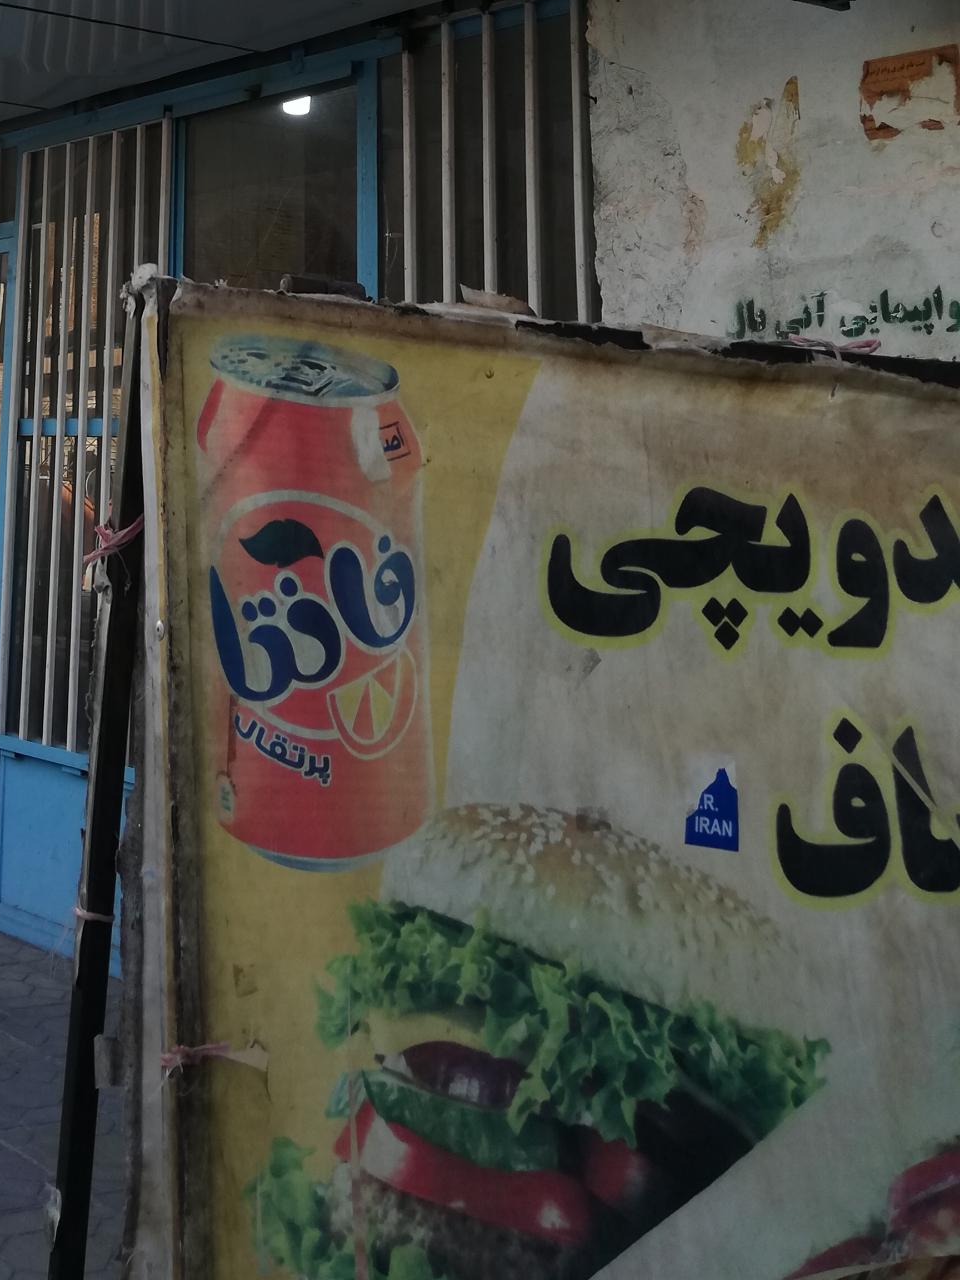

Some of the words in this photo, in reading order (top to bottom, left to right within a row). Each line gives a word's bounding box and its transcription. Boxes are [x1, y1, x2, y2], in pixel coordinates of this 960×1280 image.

[209, 533, 417, 703] فانتا
[234, 710, 331, 785] پرتقال
[694, 816, 733, 838] IRAN
